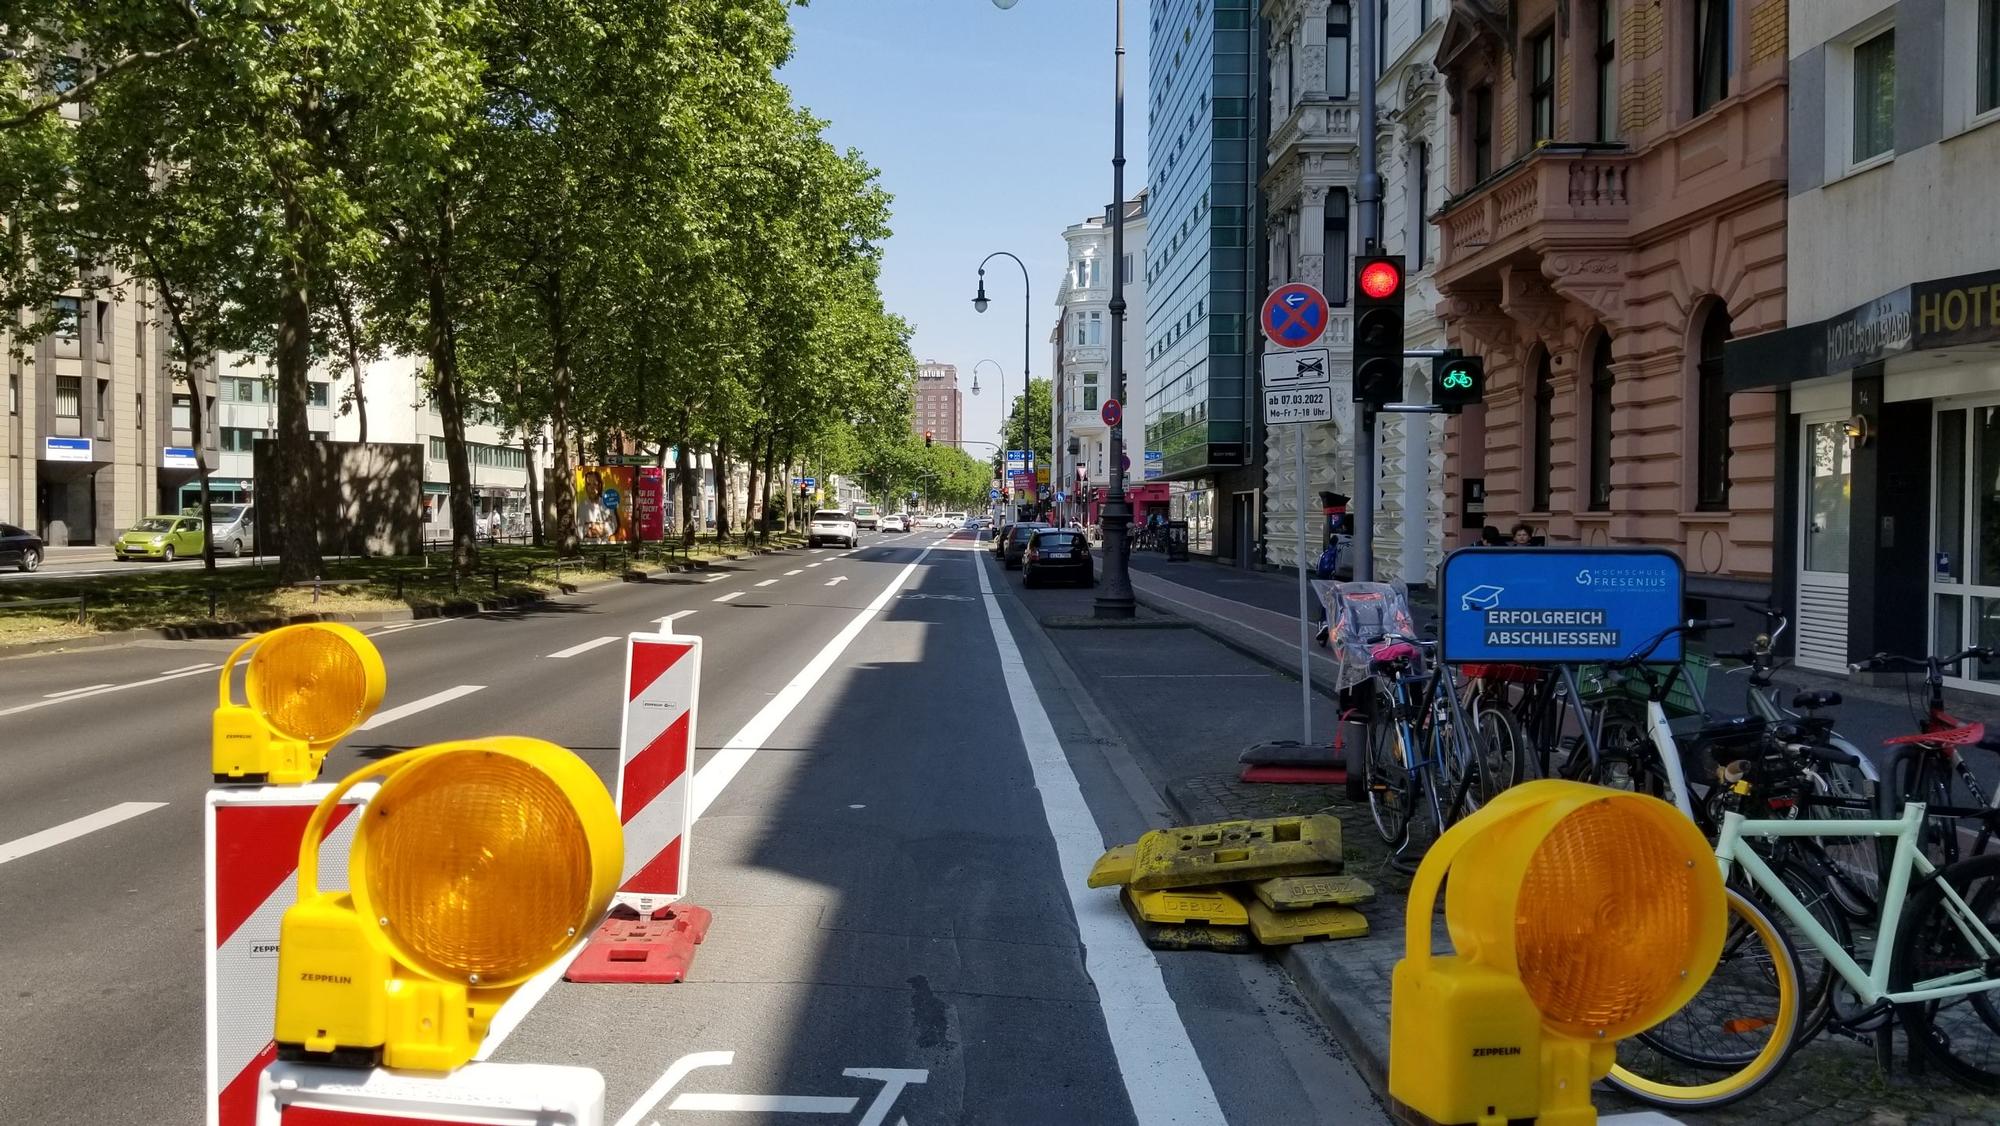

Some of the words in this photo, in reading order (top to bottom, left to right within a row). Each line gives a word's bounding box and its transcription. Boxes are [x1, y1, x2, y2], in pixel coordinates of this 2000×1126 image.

[919, 370, 945, 378] SATURN
[1269, 396, 1279, 405] ab
[1281, 394, 1324, 405] 07.03.2022
[1859, 391, 1868, 405] 14
[1270, 408, 1291, 417] Mo-Fr
[1293, 408, 1310, 417] 7-18
[1313, 407, 1325, 416] Uhr
[1594, 577, 1666, 587] FRESENIUS
[1488, 611, 1603, 625] ERFOLGREICH
[1487, 632, 1617, 646] ABSCHLIESSEN!
[1291, 880, 1352, 897] DEBUZ
[1166, 900, 1225, 913] DEBUZ
[1282, 911, 1343, 929] DEBUZ
[300, 973, 352, 985] ZEPPELIN
[1472, 1047, 1521, 1057] ZEPPELIN
